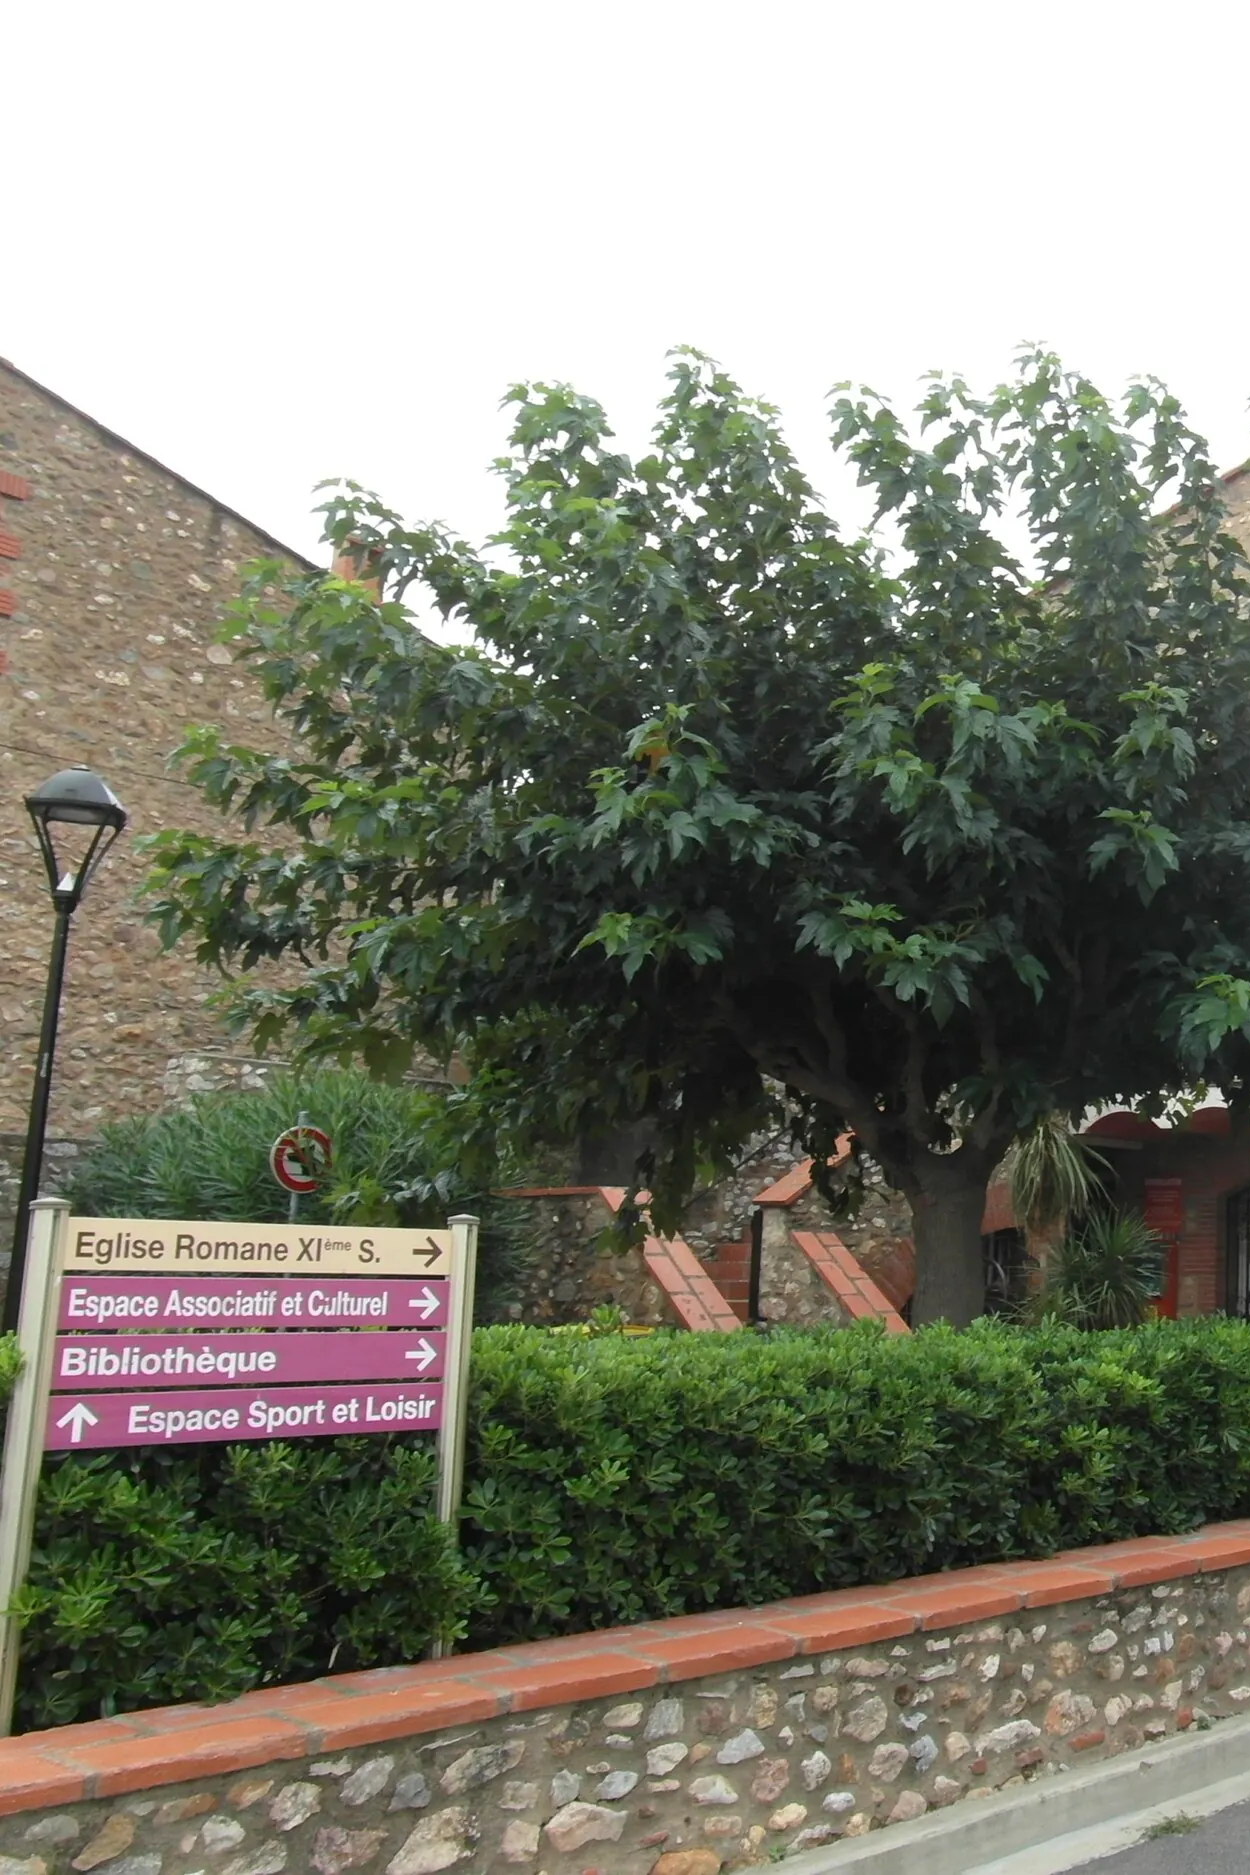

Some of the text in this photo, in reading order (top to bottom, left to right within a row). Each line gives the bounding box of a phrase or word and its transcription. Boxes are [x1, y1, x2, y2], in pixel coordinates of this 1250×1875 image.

[75, 1231, 164, 1264] Eglise
[175, 1234, 288, 1262] Romane
[358, 1239, 380, 1264] S.
[68, 1289, 388, 1322] Espace Associatif et Culturel
[60, 1347, 276, 1378] Bibliothèque
[128, 1394, 436, 1437] Espace Sport et Loisir
